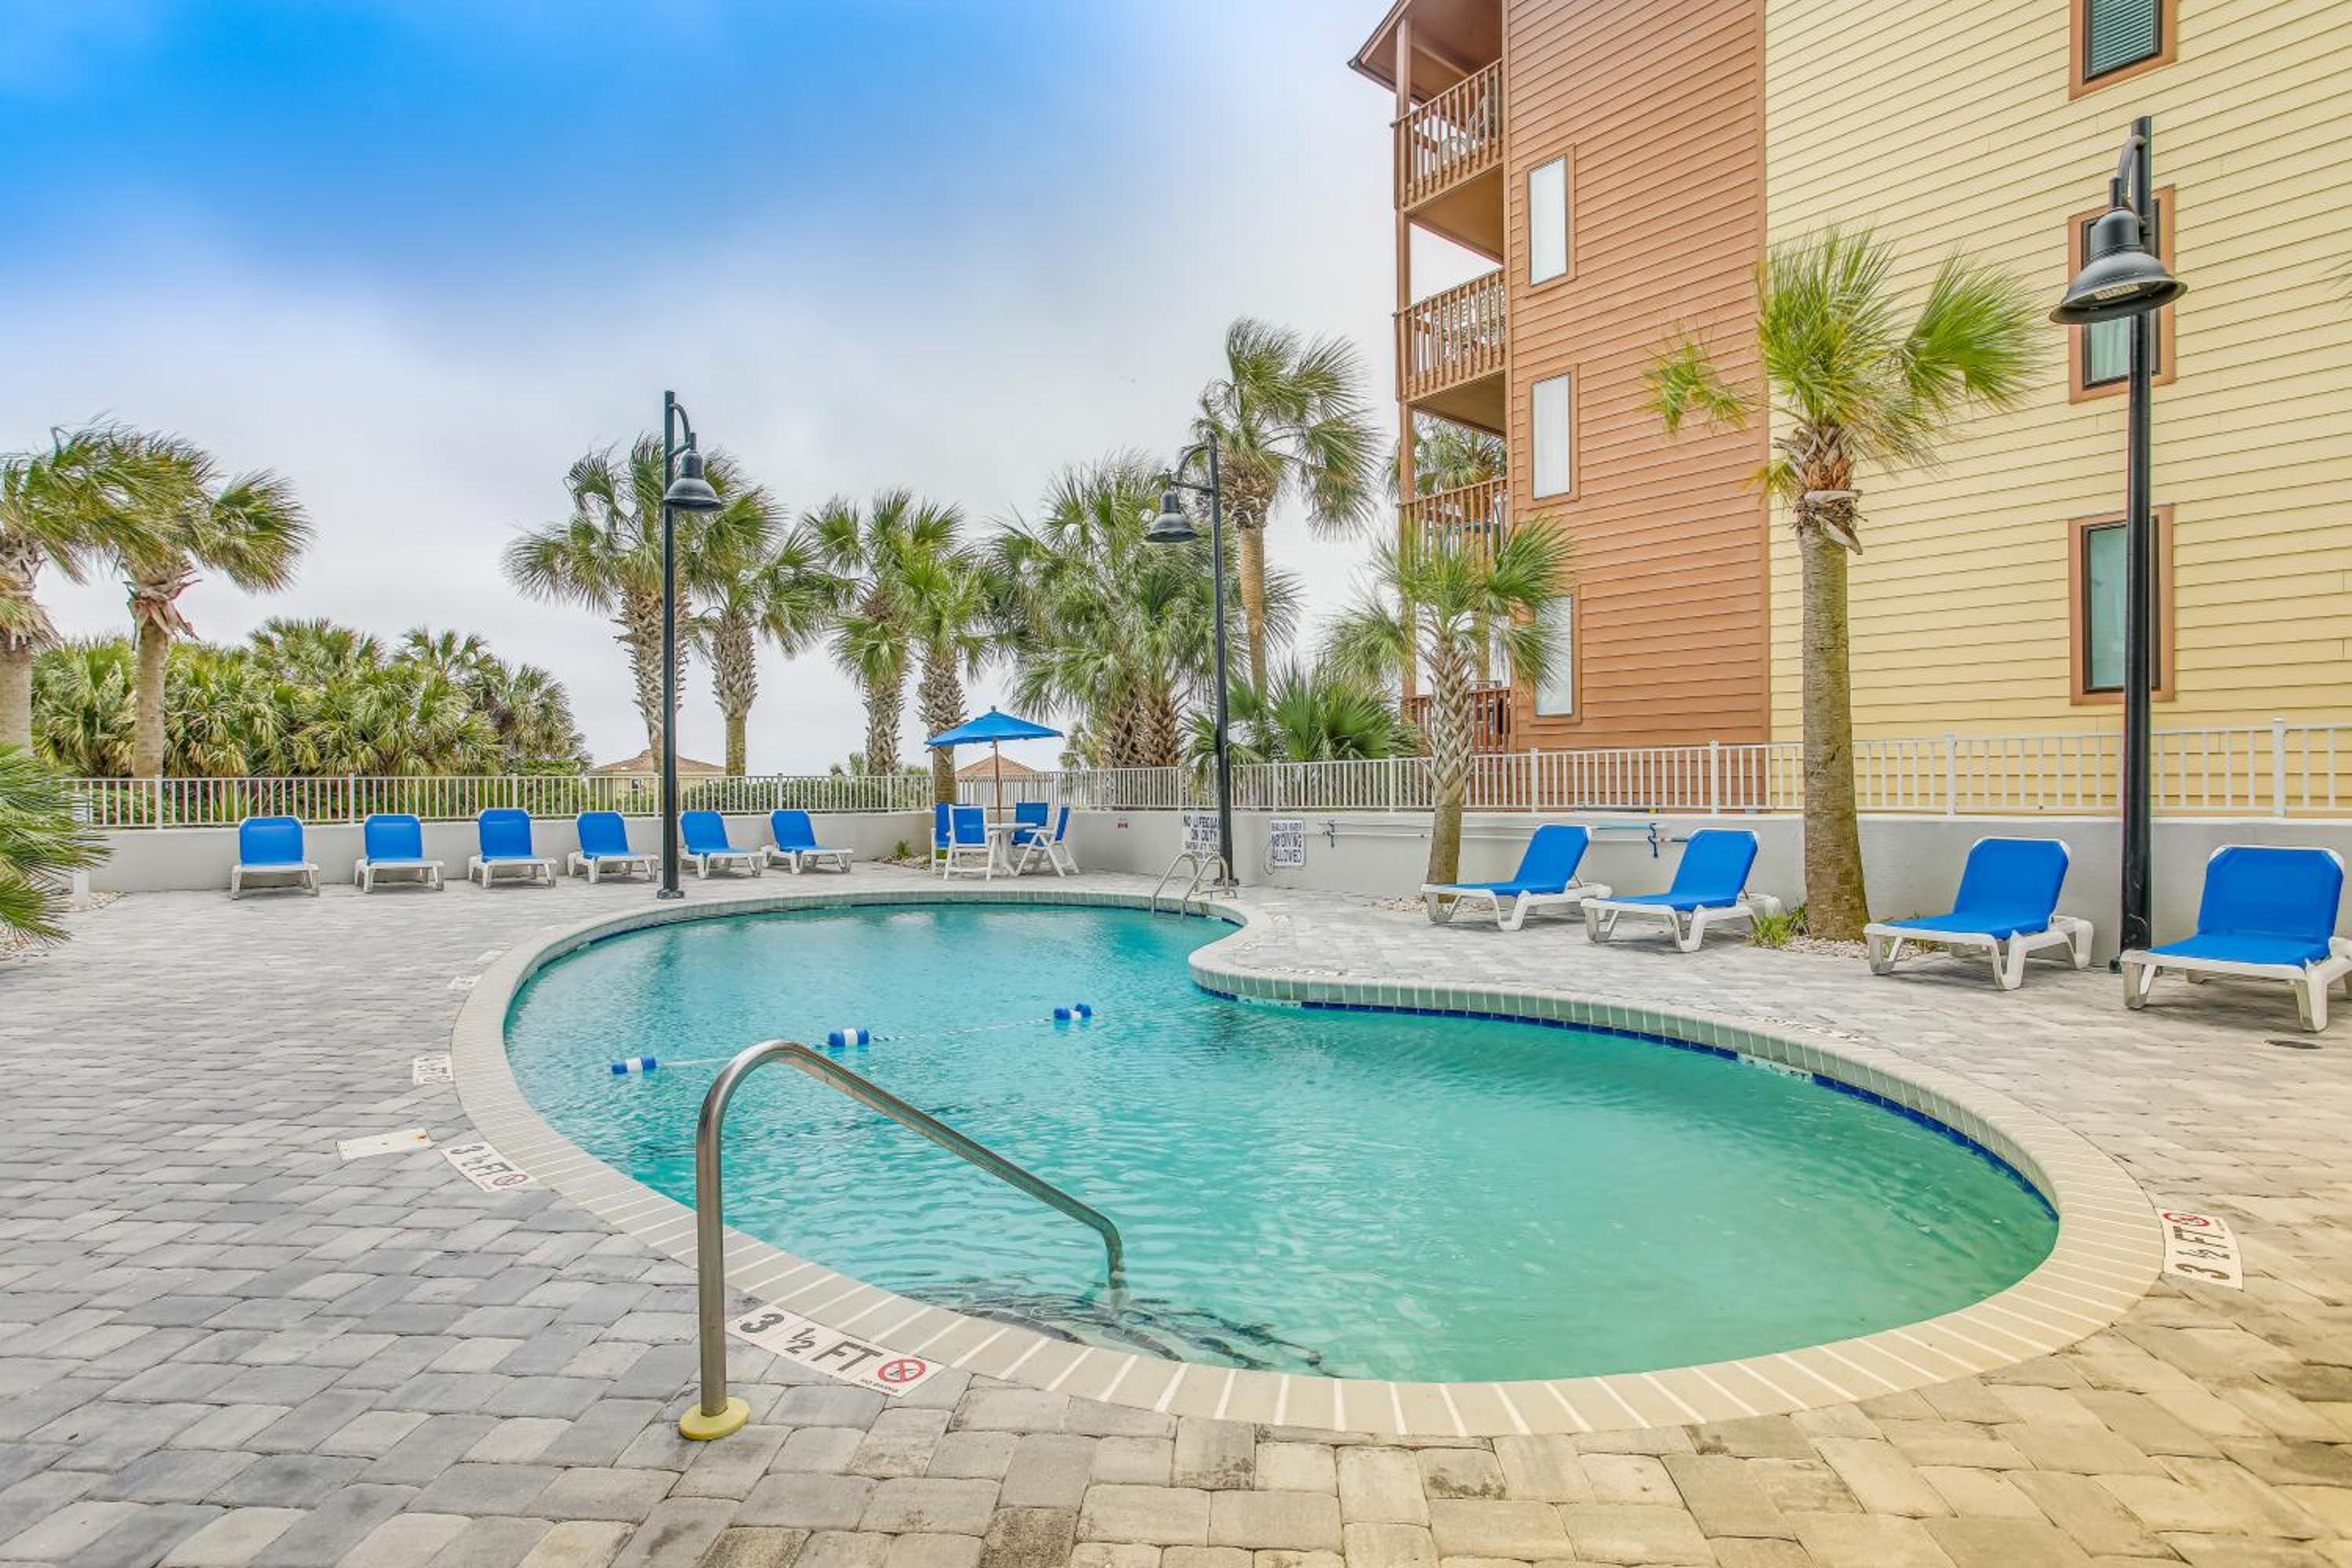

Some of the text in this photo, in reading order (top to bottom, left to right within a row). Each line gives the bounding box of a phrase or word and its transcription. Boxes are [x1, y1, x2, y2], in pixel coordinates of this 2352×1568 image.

[1184, 815, 1191, 827] NO
[1192, 829, 1217, 842] ON DUTY
[1272, 833, 1301, 847] NO DIVING
[1272, 849, 1301, 862] ALLOWED
[468, 1162, 514, 1177] FT
[2173, 1225, 2228, 1249] FT
[2175, 1263, 2230, 1280] 3
[739, 1313, 785, 1334] 3
[811, 1340, 884, 1372] FT
